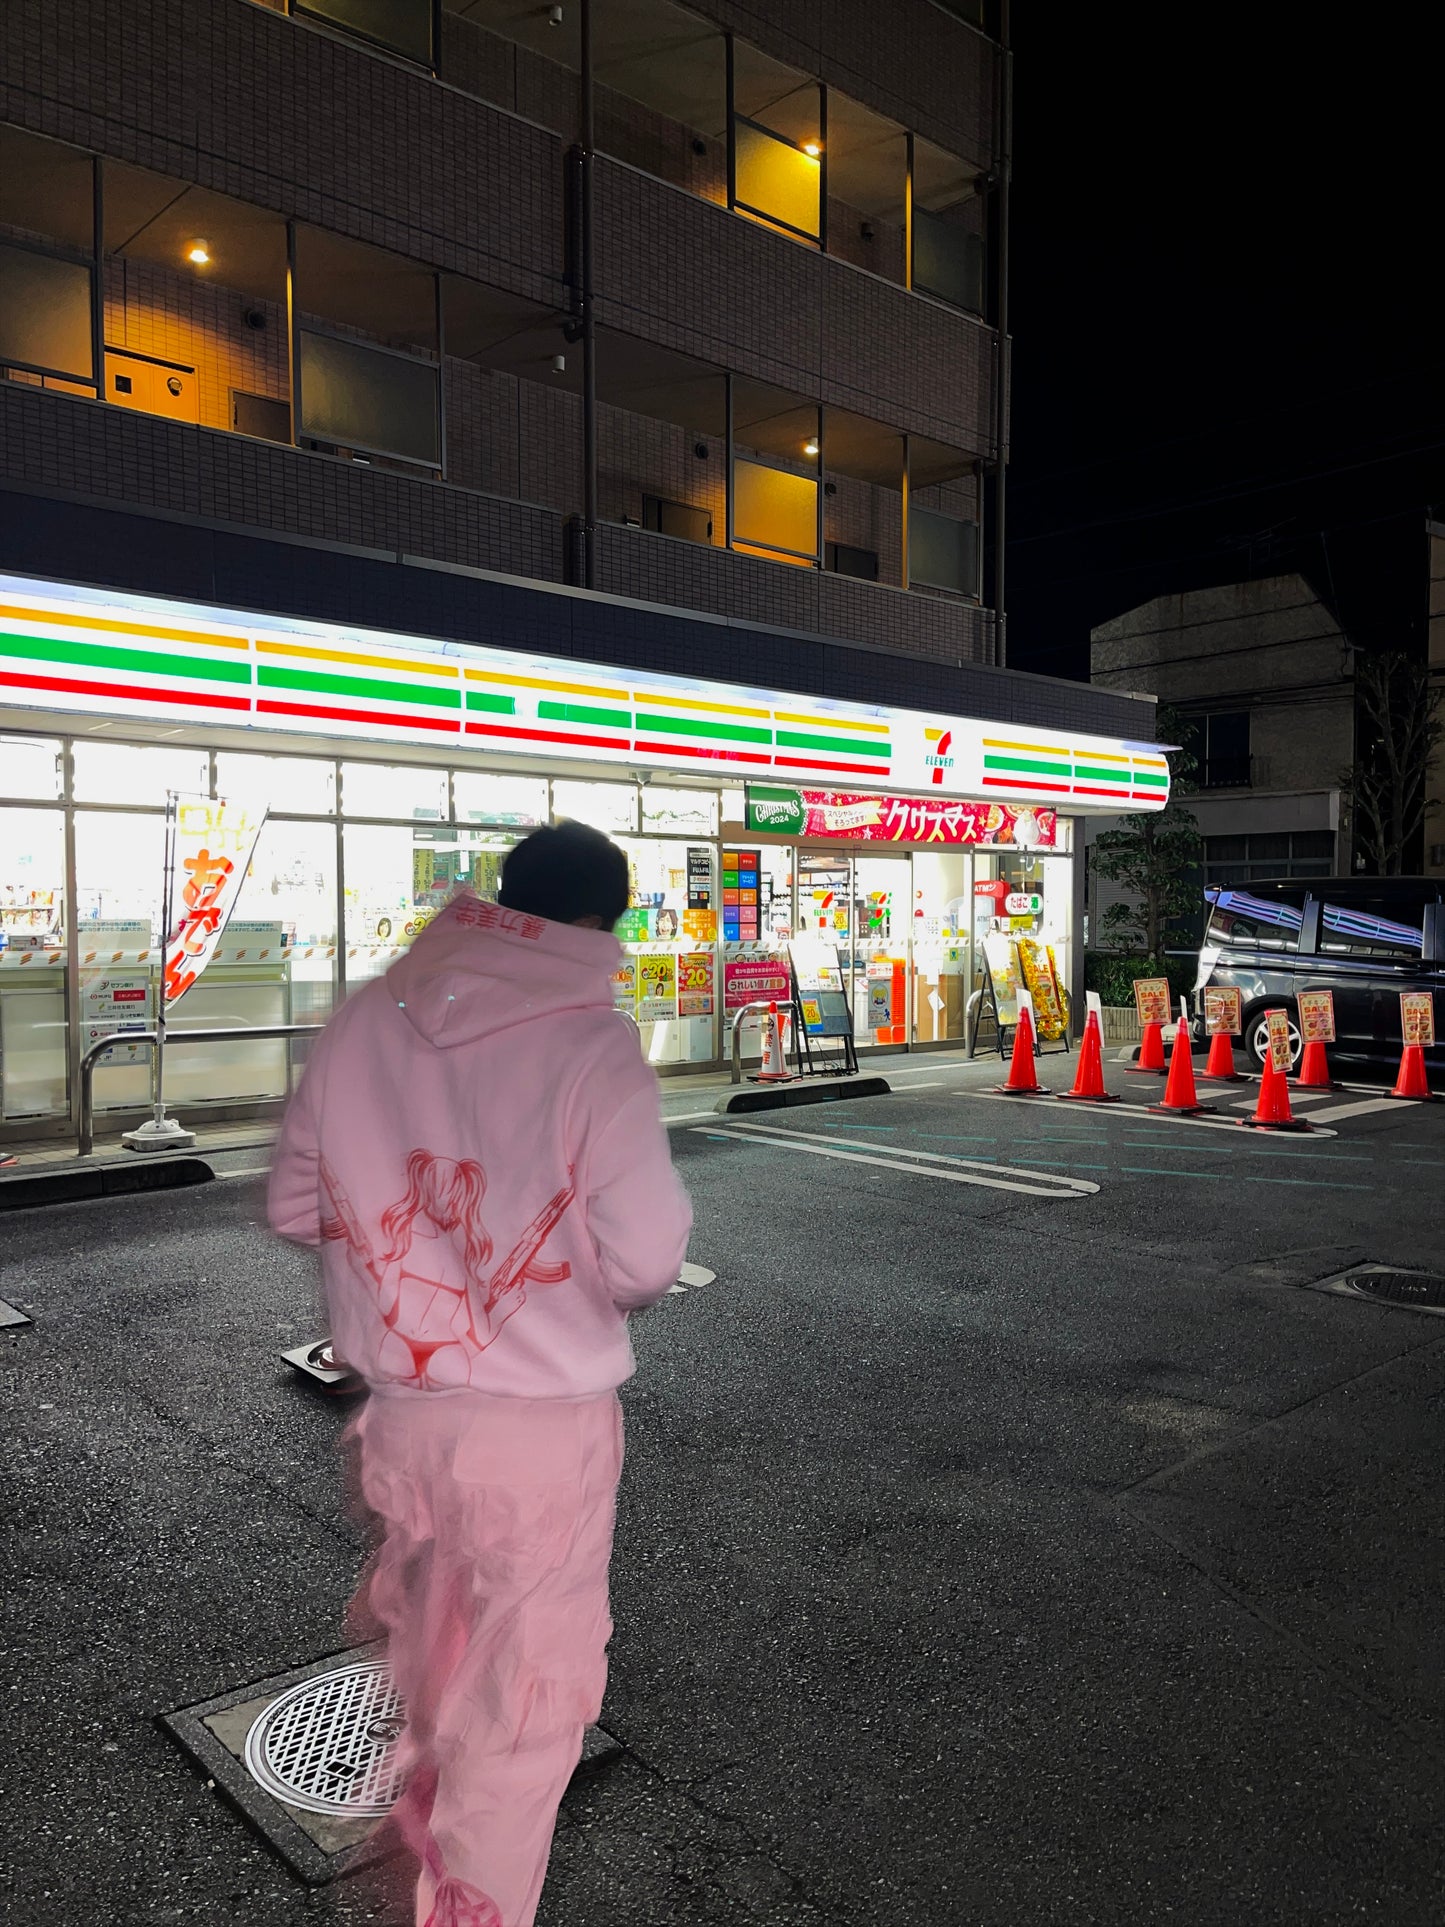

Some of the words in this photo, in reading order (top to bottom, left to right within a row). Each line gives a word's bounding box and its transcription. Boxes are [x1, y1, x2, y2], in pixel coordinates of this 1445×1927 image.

[755, 800, 800, 823] CHRISTMAS
[770, 815, 790, 825] 2024
[886, 800, 976, 842] クリスマス
[974, 884, 989, 892] ATM
[1141, 990, 1165, 998] SALE
[1271, 1027, 1287, 1036] SALE
